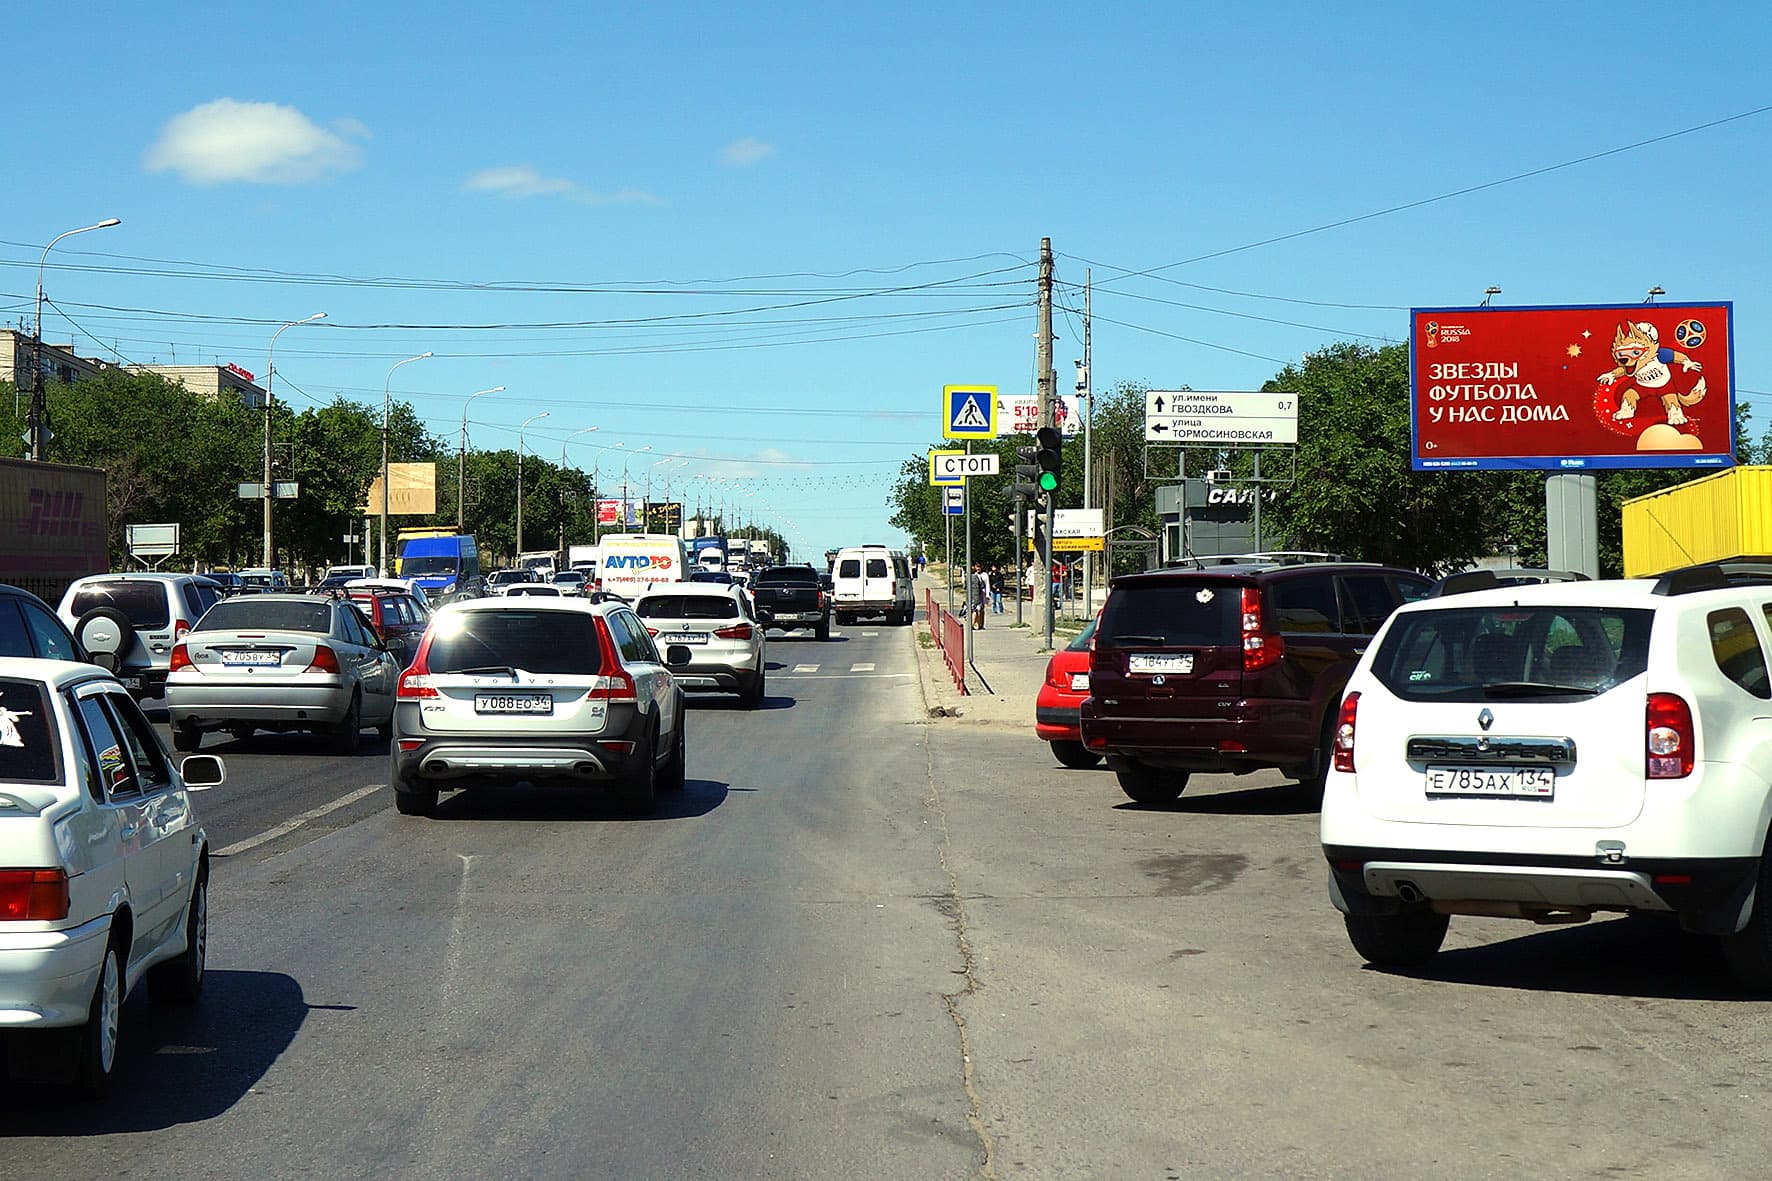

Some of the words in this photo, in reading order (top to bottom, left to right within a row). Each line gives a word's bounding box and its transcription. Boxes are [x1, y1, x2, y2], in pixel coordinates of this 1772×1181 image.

[1441, 335, 1461, 343] 2018
[1428, 362, 1518, 381] ЗВЕЗДЫ
[1428, 383, 1538, 401] ФУТБОЛА
[1172, 404, 1233, 415] ГВОЗДКОВА
[1278, 401, 1292, 411] 0,7
[1428, 406, 1444, 423] У
[1449, 405, 1495, 423] НАС
[1500, 404, 1570, 424] ДОМА
[1172, 419, 1202, 428] улица
[1172, 429, 1273, 440] ТОРМОСИНОВСКАЯ
[945, 457, 991, 473] СТОП
